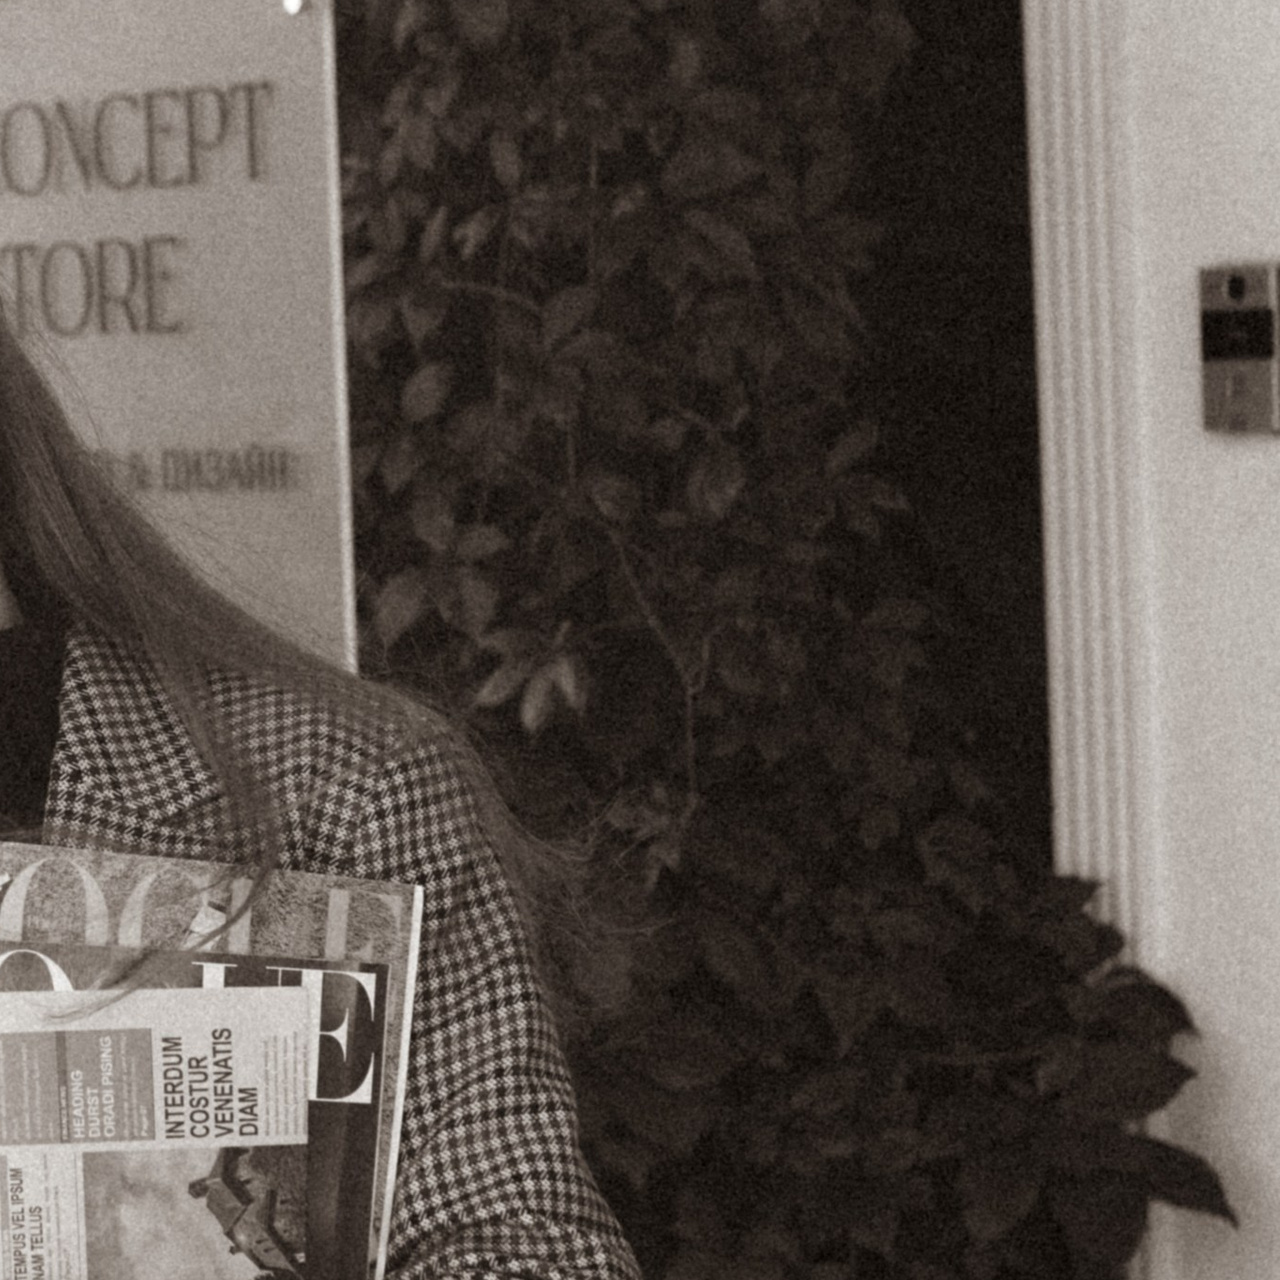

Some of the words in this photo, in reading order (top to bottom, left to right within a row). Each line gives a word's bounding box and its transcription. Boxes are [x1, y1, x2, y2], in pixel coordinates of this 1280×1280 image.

[100, 1036, 113, 1085] PISING
[212, 1028, 234, 1138] VENENATIS
[71, 1070, 85, 1138] HEADING
[87, 1087, 100, 1138] DURST
[162, 1037, 185, 1139] INTERDUM
[188, 1056, 209, 1138] COSTUR
[238, 1087, 258, 1136] DIAM
[102, 1090, 115, 1137] ORADI
[10, 1168, 24, 1205] IPSUM
[11, 1207, 25, 1230] VEL
[30, 1206, 44, 1251] TELLUS
[12, 1234, 28, 1280] TEMPUS
[32, 1255, 44, 1280] NAM
